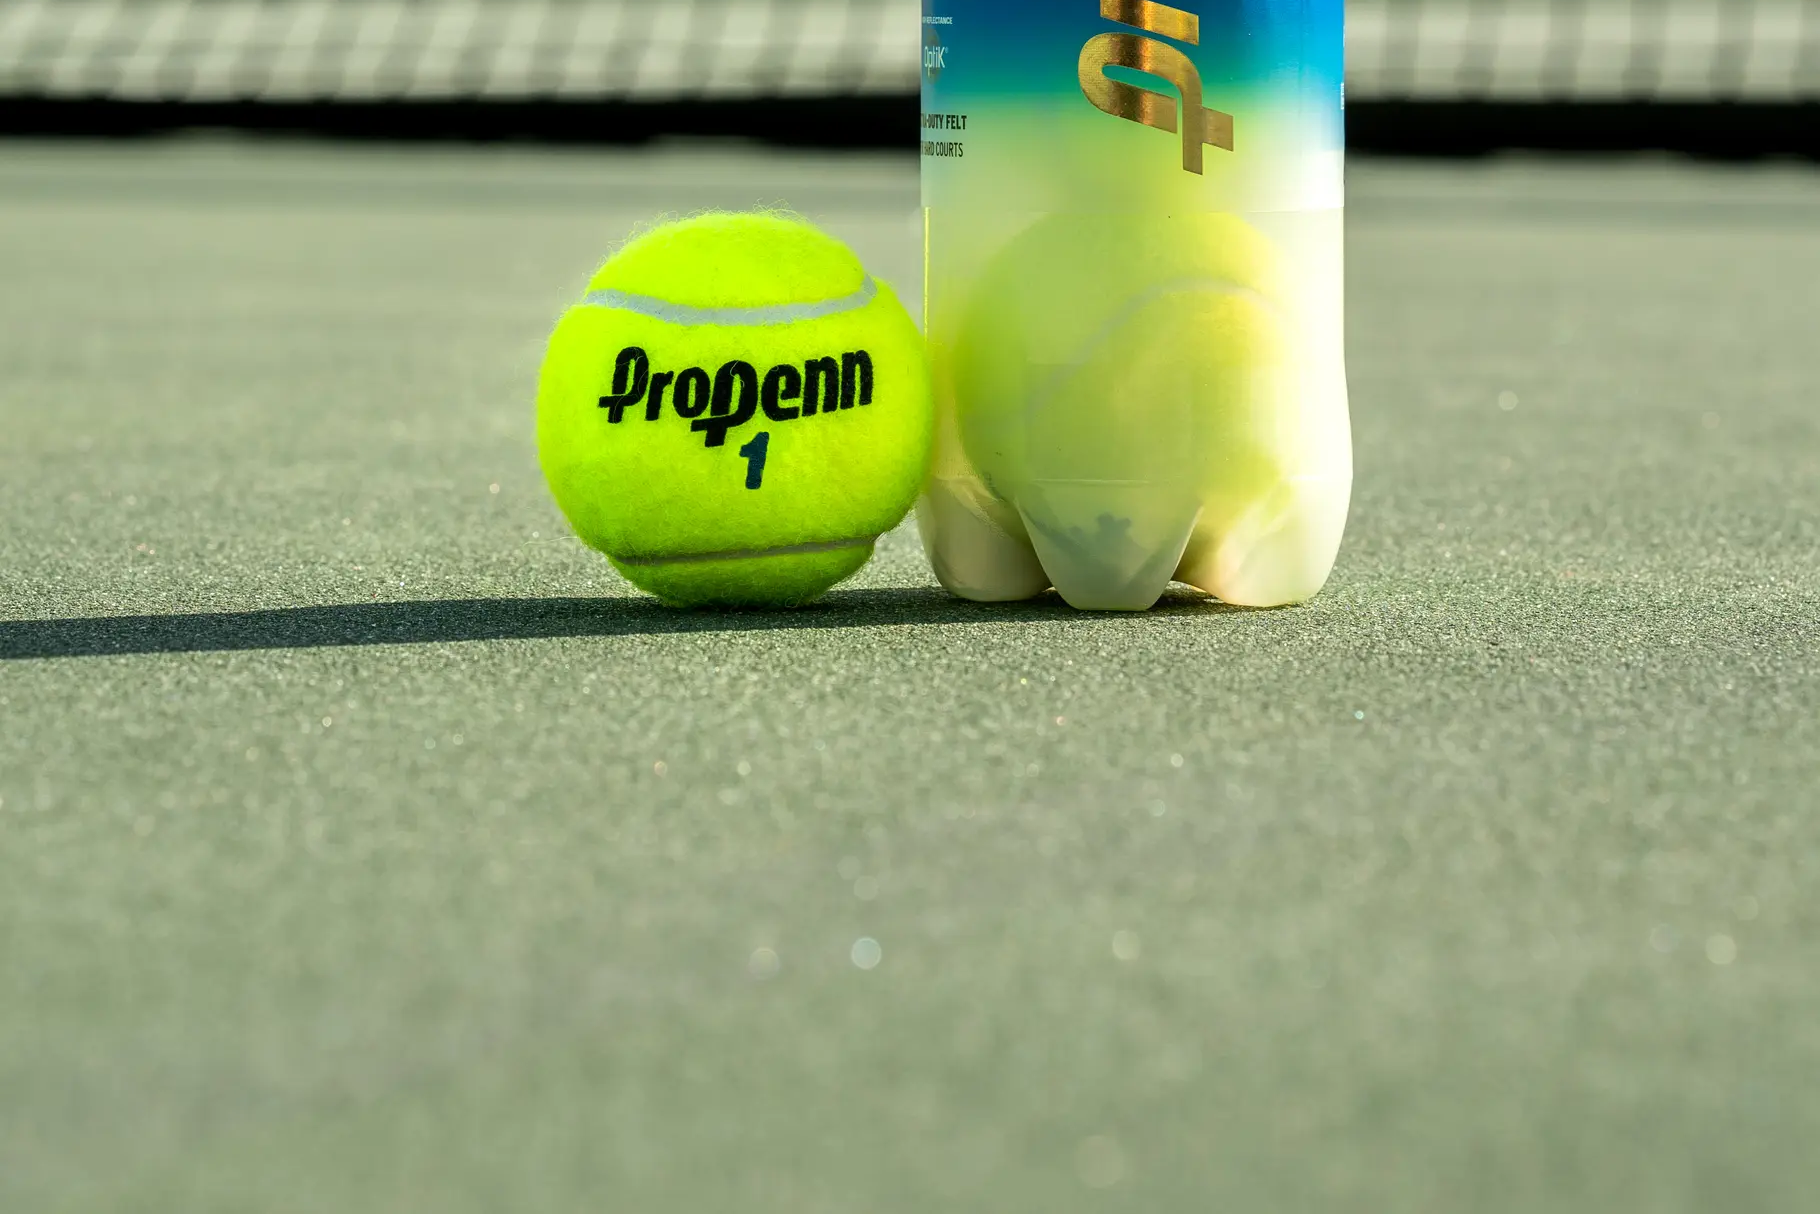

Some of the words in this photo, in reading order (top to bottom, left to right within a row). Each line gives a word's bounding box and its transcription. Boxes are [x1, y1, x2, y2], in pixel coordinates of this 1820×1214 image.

[945, 114, 968, 130] FELT
[935, 141, 964, 158] COURTS
[739, 430, 770, 490] 1
